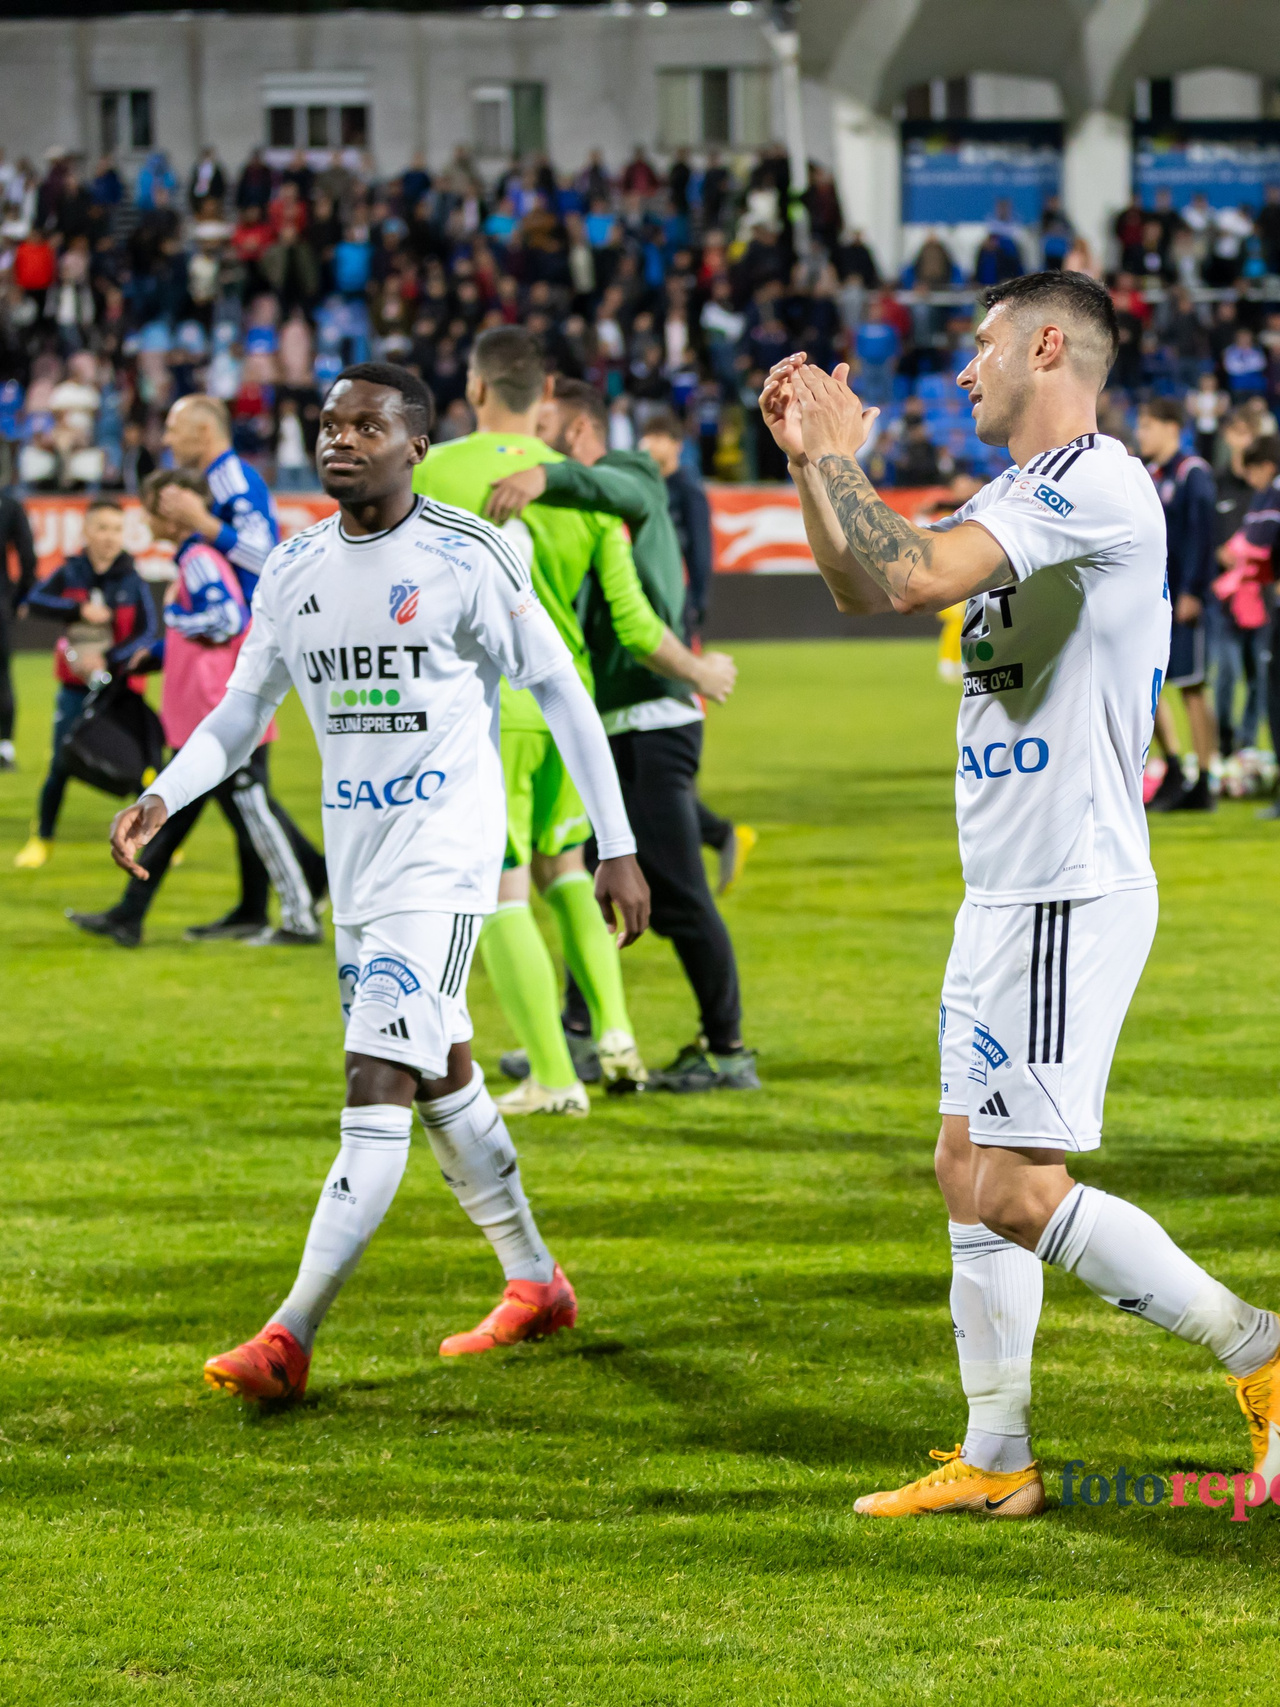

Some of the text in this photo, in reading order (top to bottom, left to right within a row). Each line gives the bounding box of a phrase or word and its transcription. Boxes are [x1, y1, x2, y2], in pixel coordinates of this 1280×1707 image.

[303, 646, 429, 684] UNIBET
[990, 670, 1015, 689] 0%
[394, 714, 420, 732] 0%
